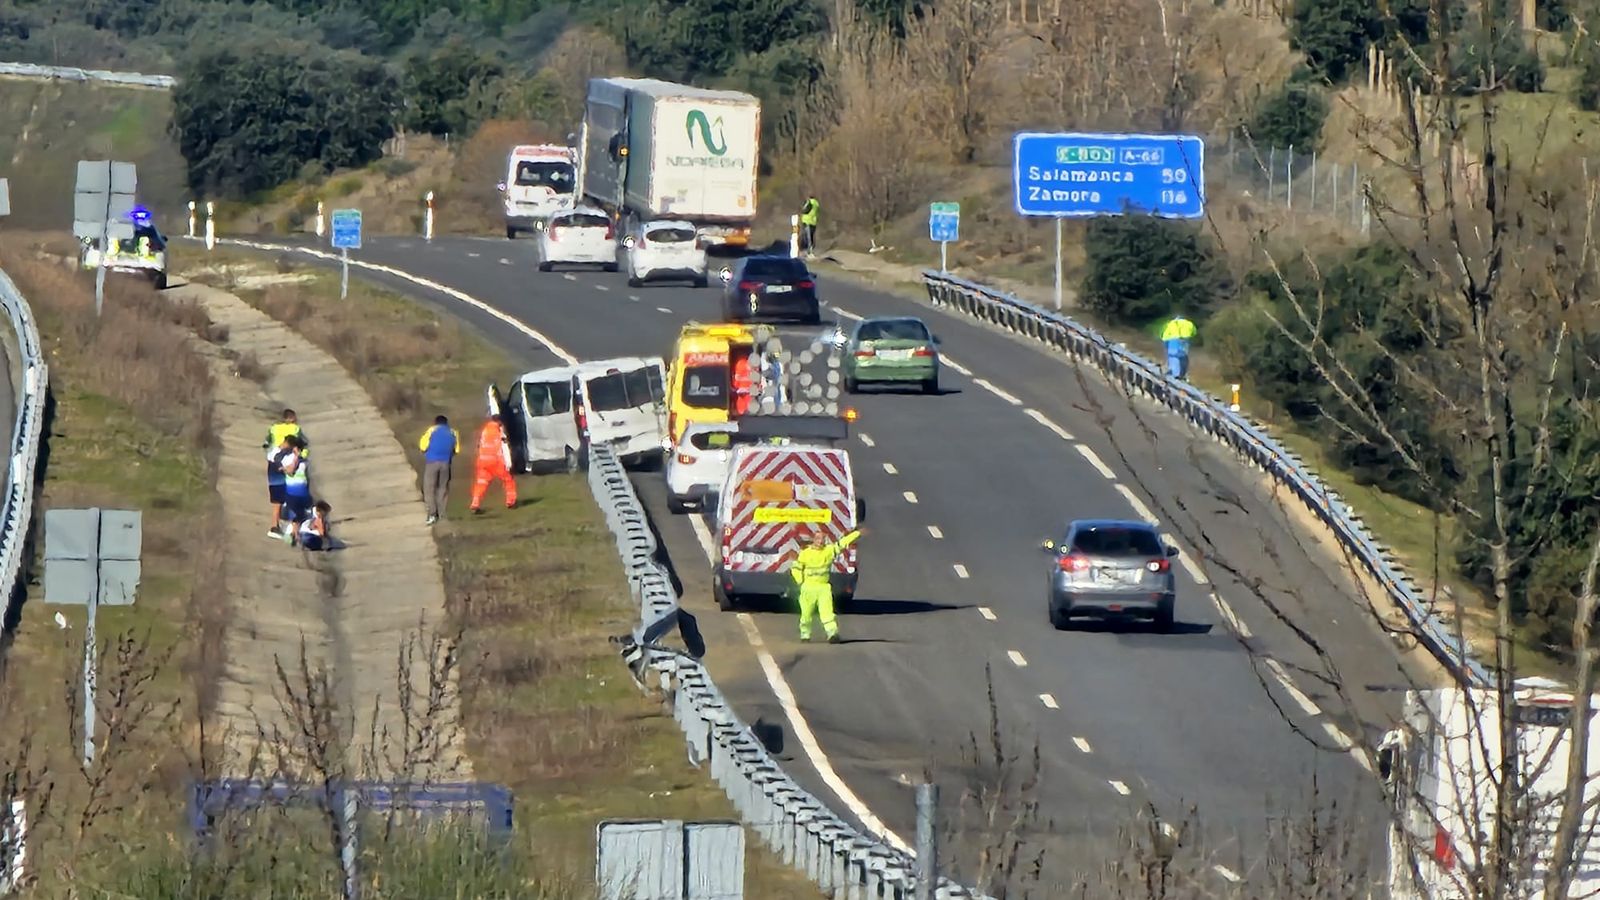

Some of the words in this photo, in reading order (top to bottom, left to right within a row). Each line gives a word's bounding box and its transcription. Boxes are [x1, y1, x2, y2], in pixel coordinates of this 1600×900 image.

[1029, 167, 1134, 182] Salamanca
[1161, 168, 1187, 183] 50
[1029, 187, 1100, 203] Zamora
